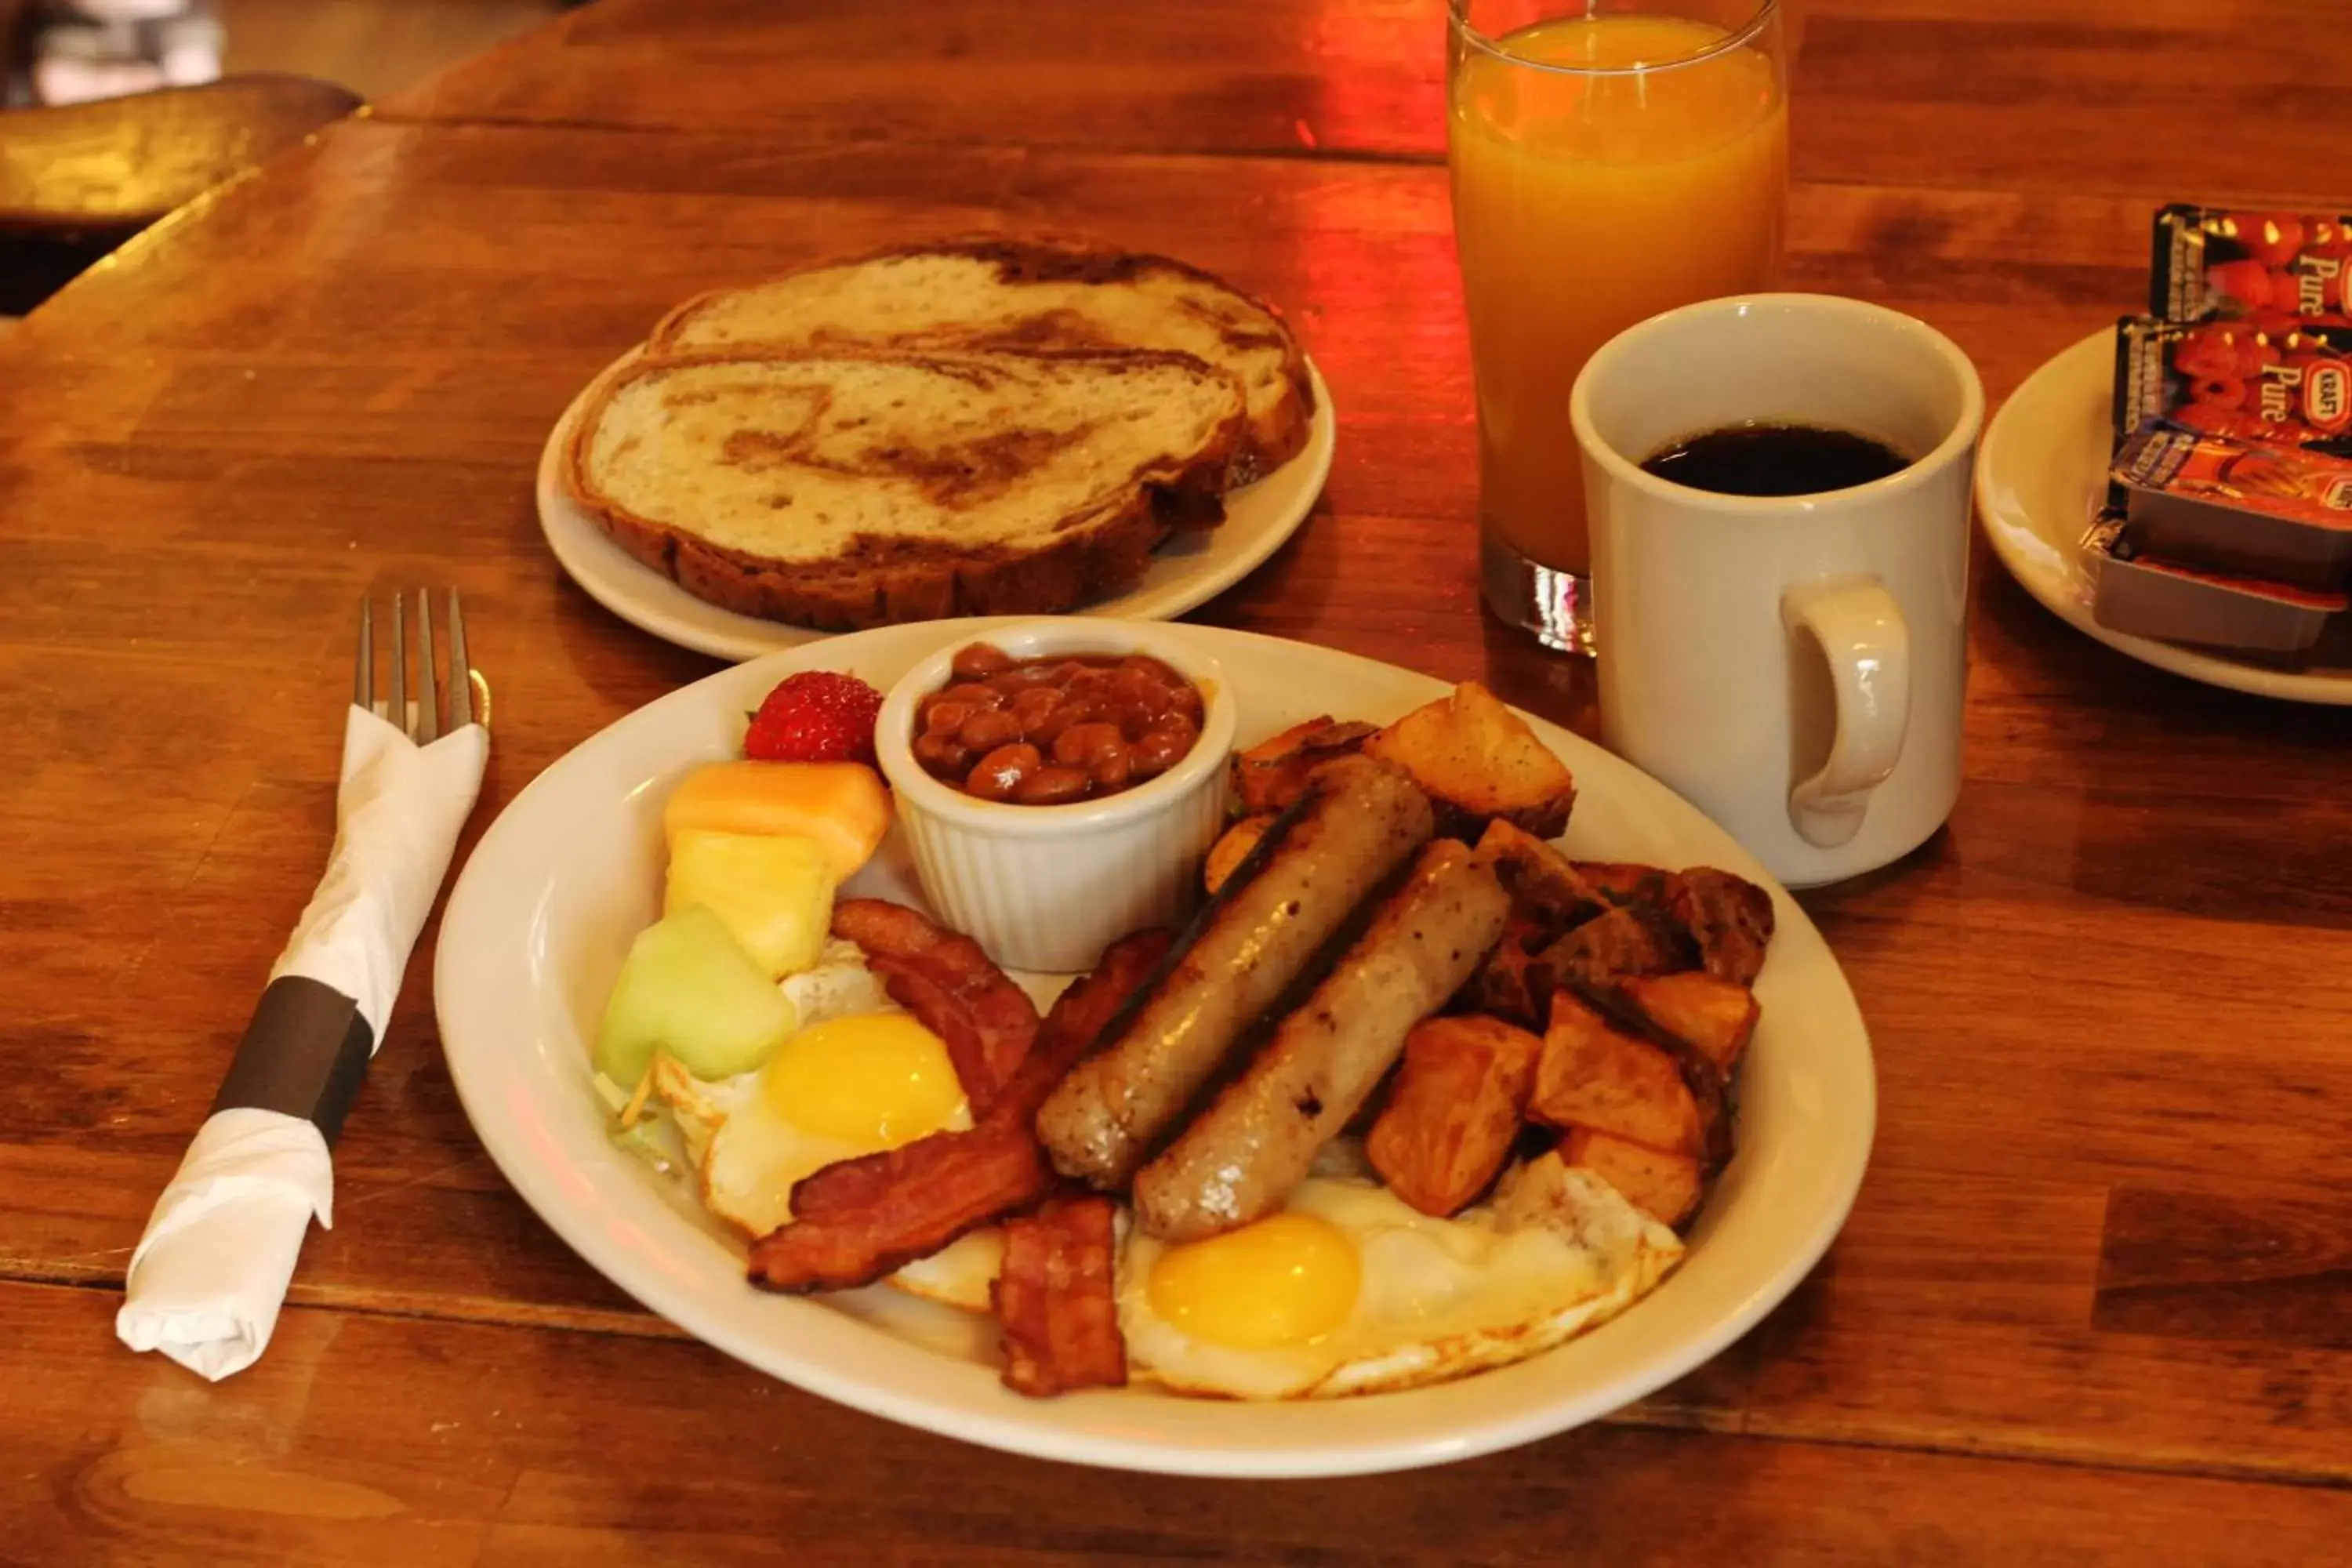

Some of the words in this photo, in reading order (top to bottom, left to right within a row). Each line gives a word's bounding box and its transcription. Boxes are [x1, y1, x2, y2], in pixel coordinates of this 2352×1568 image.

[2299, 254, 2339, 317] Pure
[2261, 363, 2303, 423] Pure
[2319, 372, 2337, 415] KRAFT
